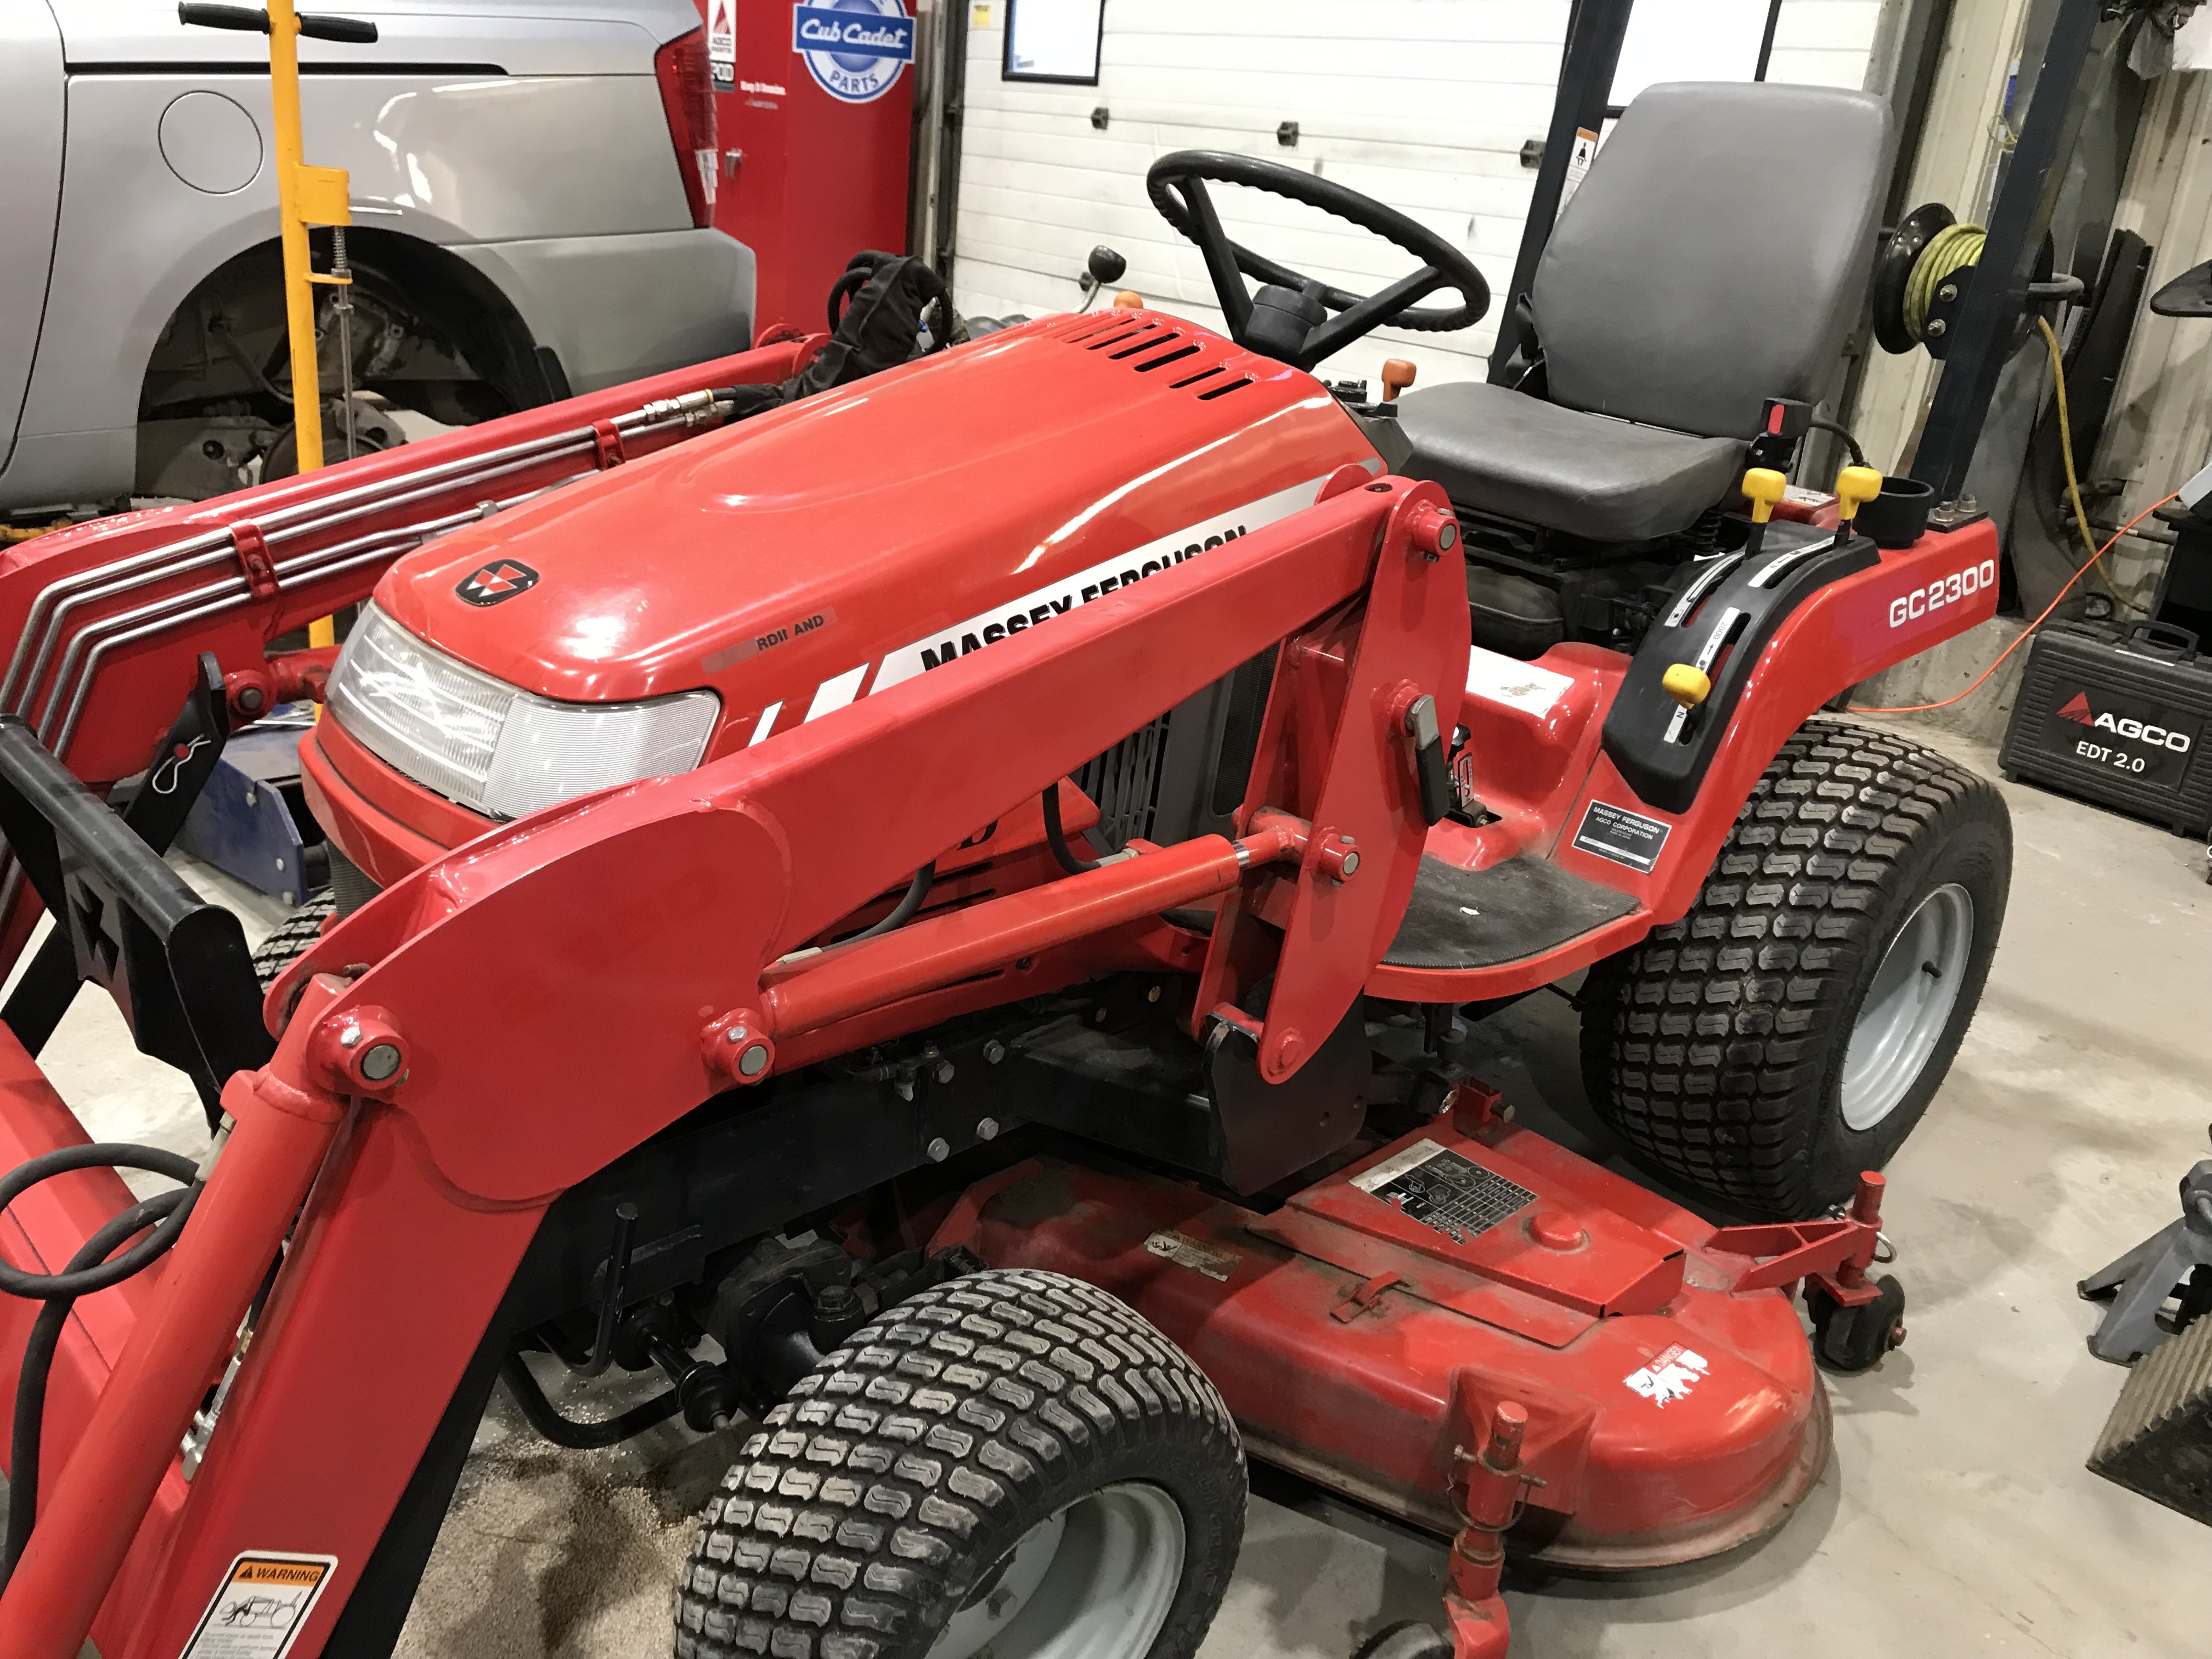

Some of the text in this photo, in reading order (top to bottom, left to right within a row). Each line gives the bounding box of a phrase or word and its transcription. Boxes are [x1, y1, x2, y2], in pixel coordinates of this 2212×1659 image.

[800, 18, 907, 49] Cub Cadet
[829, 70, 878, 92] PARTS
[794, 615, 824, 636] AND
[1713, 621, 1728, 640] 2000
[2094, 713, 2191, 753] AGCO
[2076, 741, 2145, 772] EDT 2.0
[1593, 806, 1622, 820] MASSEY
[1595, 816, 1612, 826] AGCO
[1612, 822, 1654, 840] CORPORATION
[256, 1566, 320, 1582] WARNING
